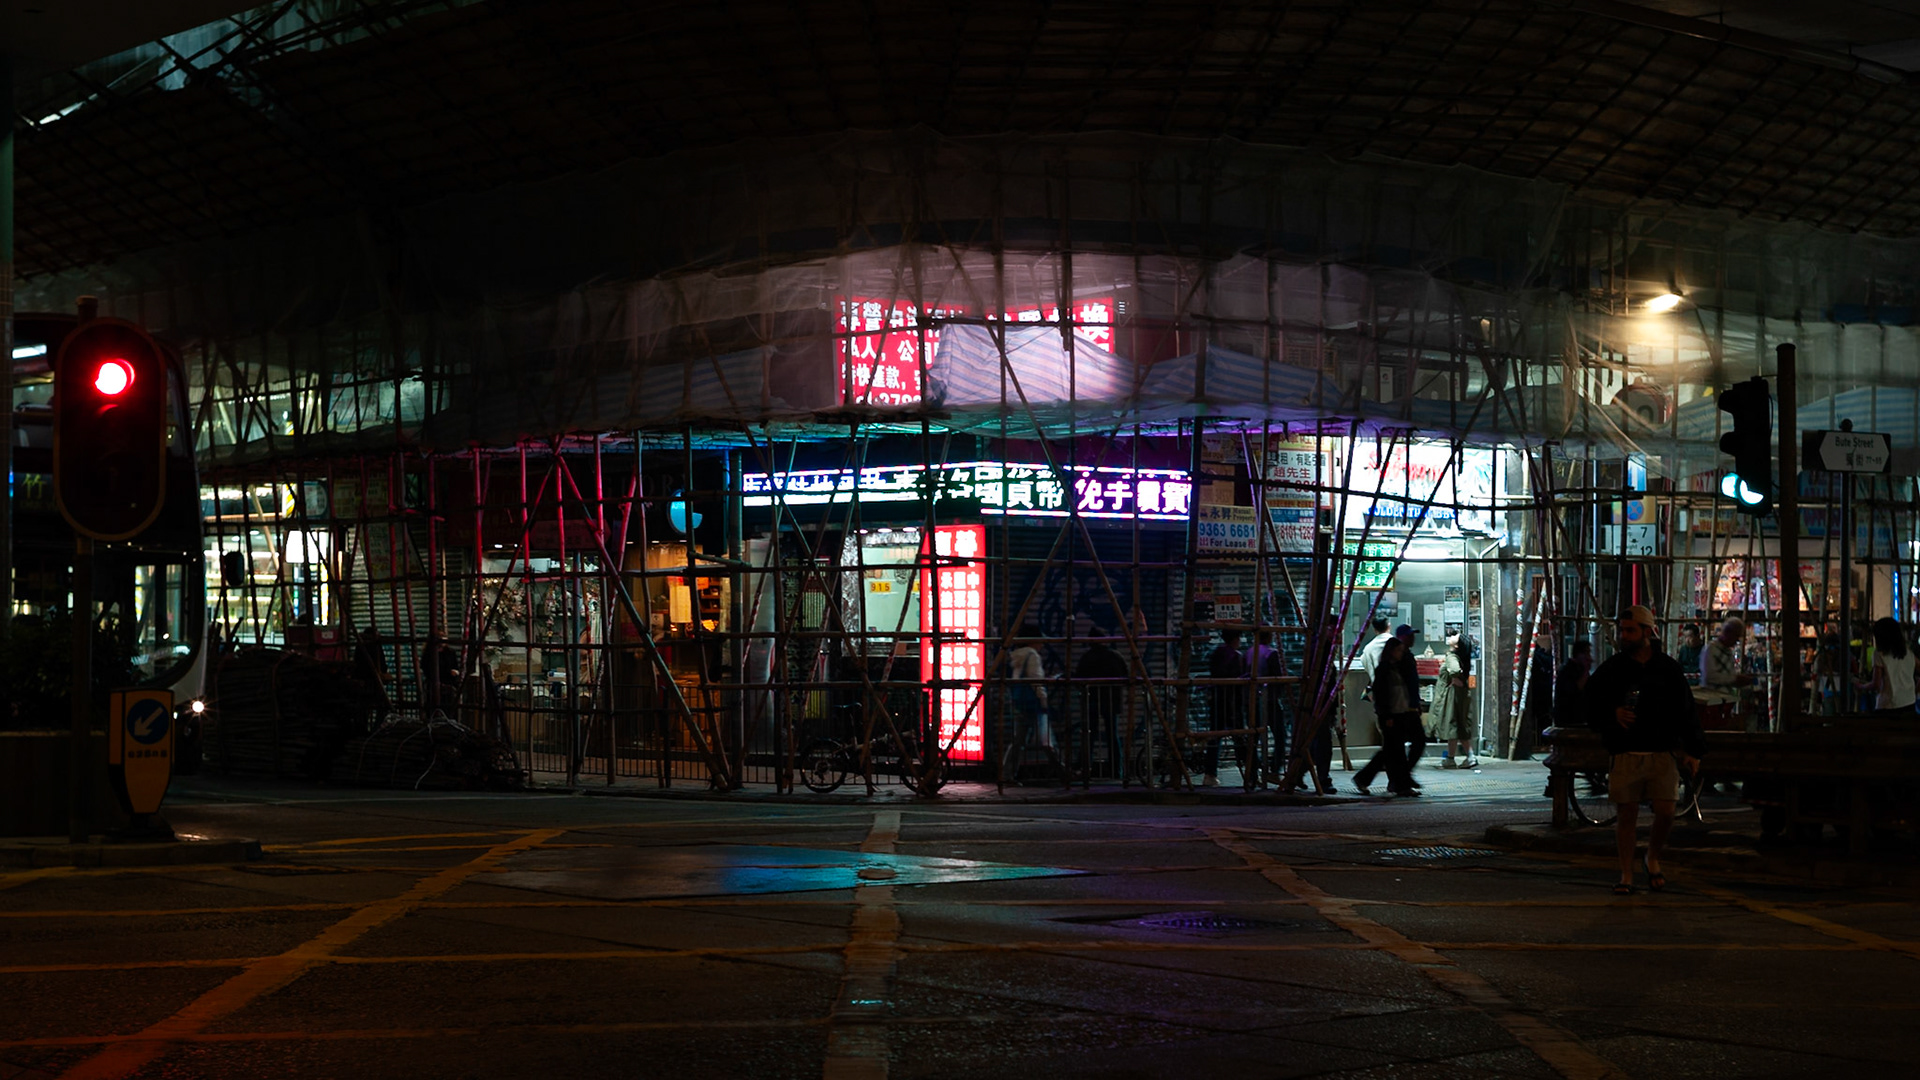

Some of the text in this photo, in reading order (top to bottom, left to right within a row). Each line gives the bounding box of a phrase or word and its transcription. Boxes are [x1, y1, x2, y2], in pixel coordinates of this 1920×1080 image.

[1834, 436, 1874, 448] Bute Street
[1199, 523, 1255, 538] 9363 6681
[1210, 538, 1223, 547] For
[1225, 539, 1247, 548] Lease
